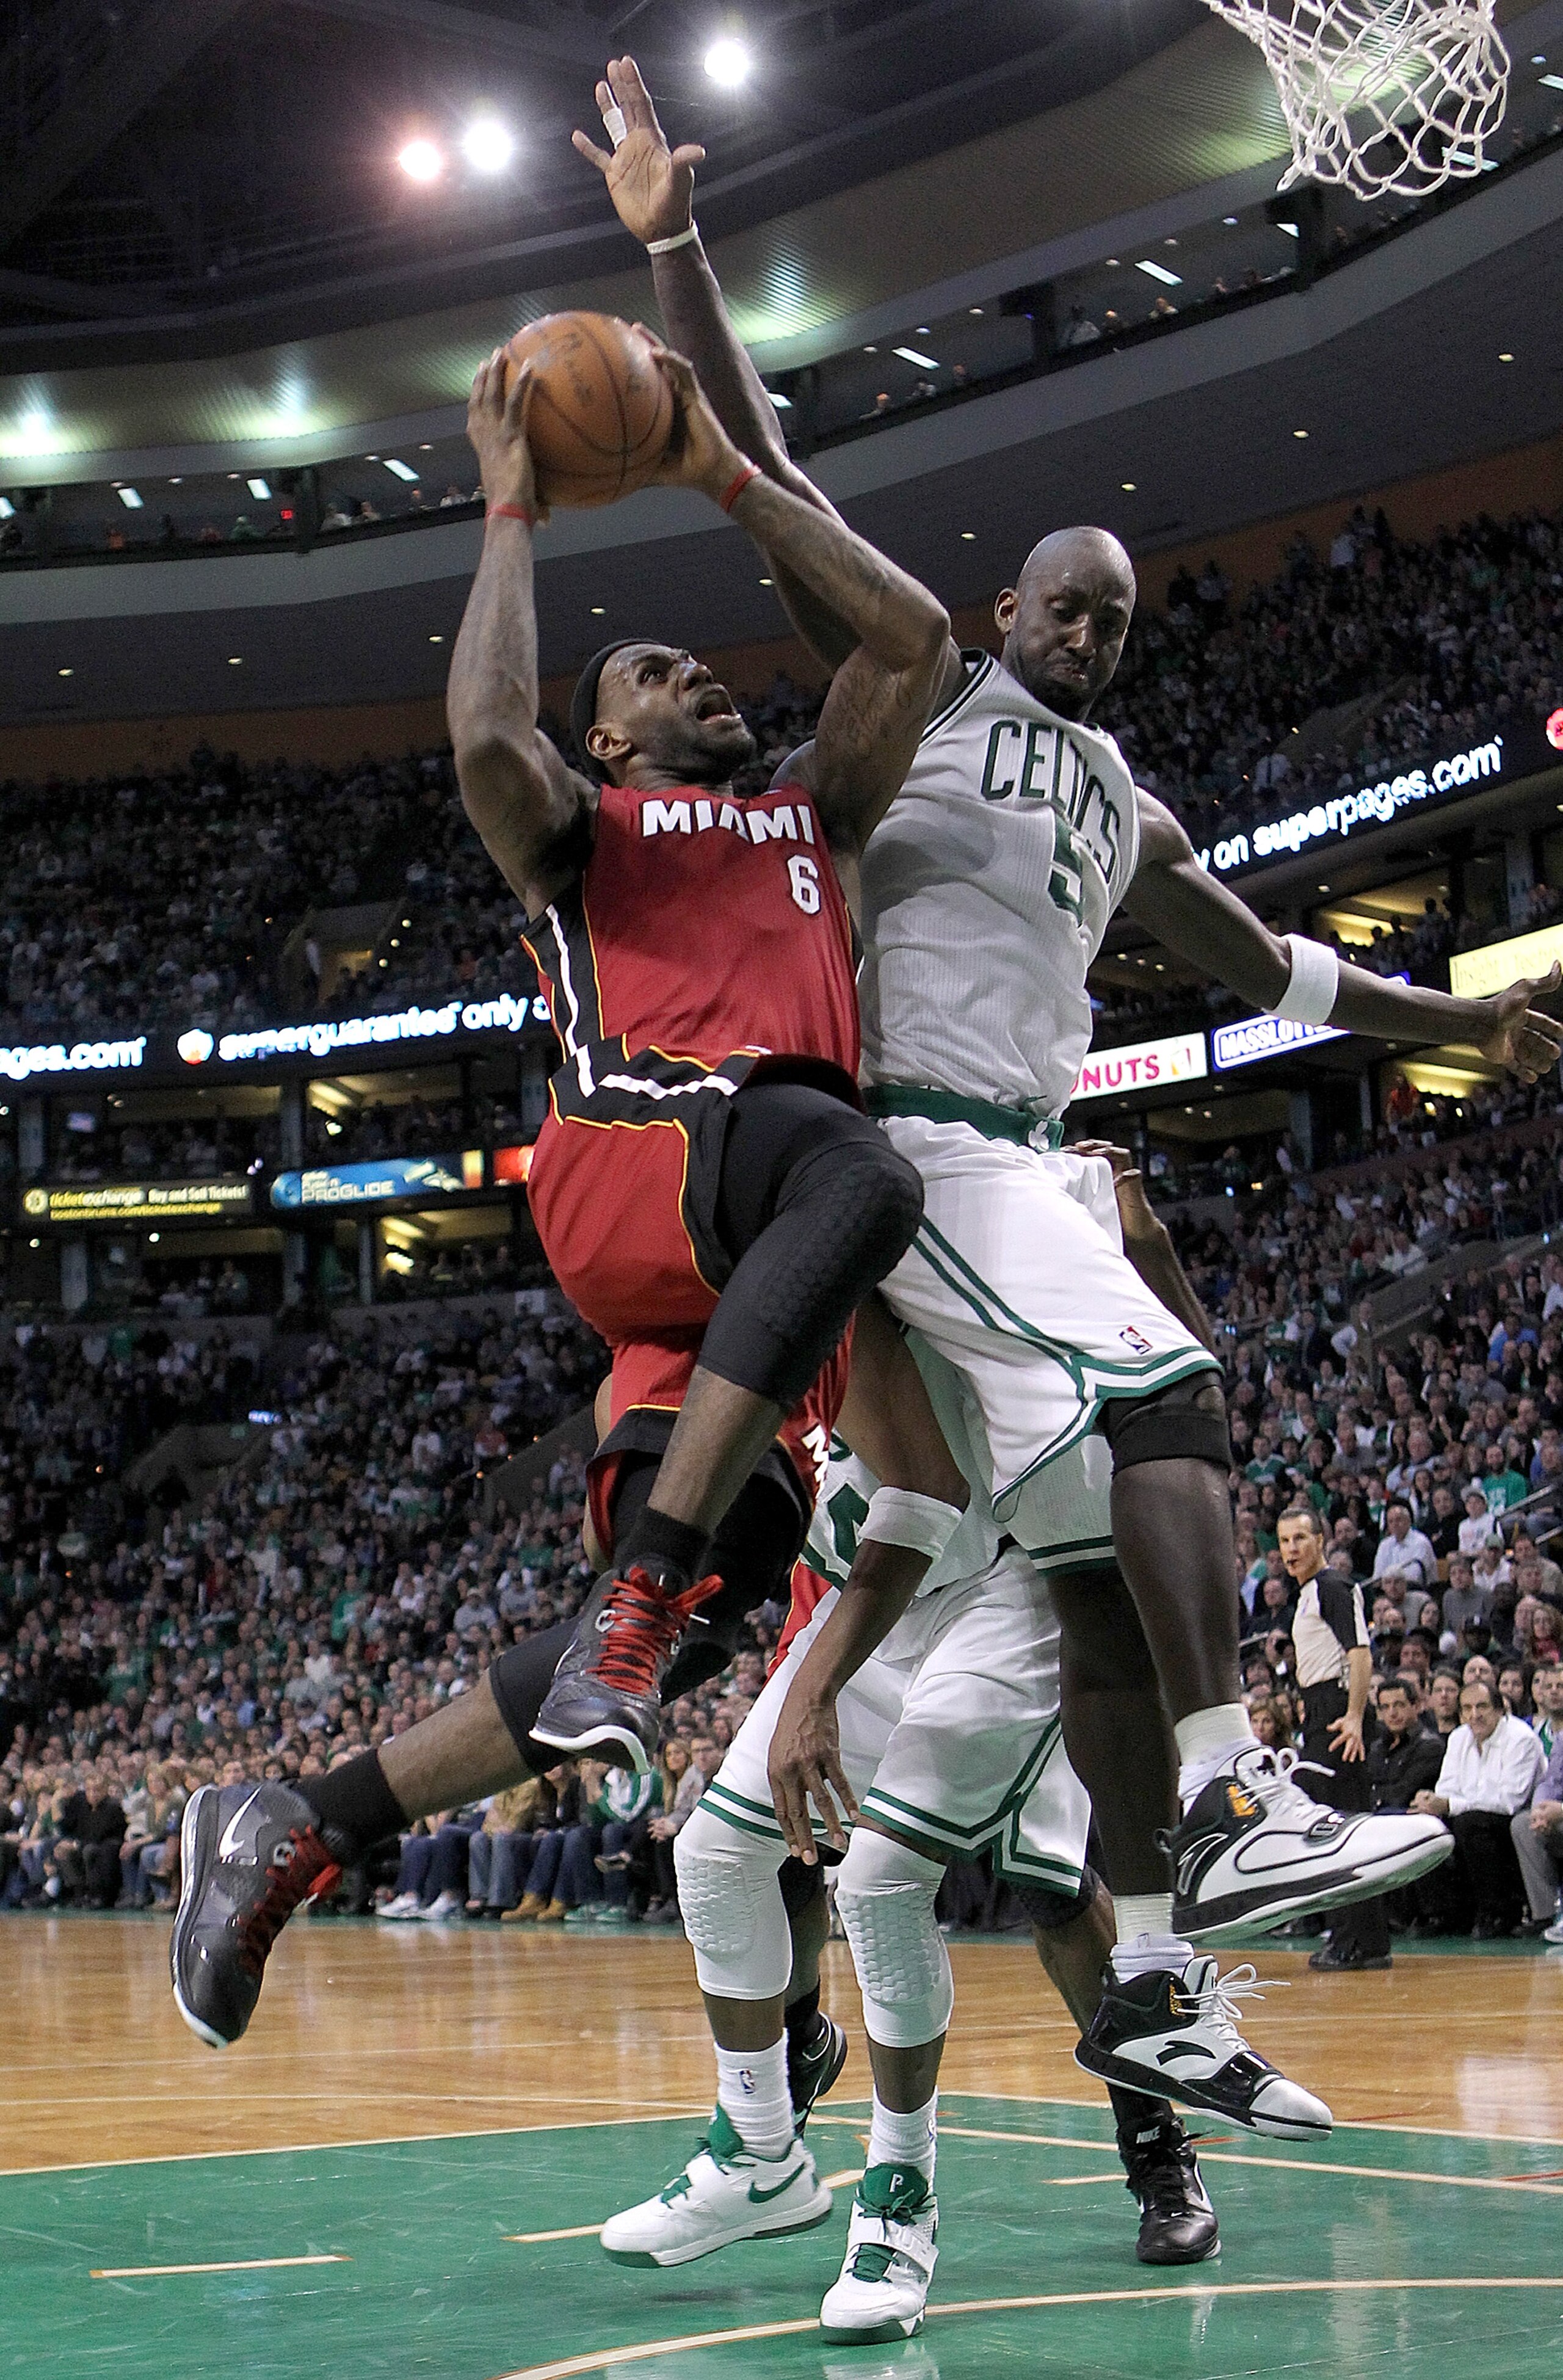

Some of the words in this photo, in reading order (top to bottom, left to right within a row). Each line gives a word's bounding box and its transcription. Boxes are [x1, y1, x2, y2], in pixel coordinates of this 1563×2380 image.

[642, 799, 815, 845] MIAMI
[1191, 845, 1211, 872] y
[1213, 834, 1250, 870] on
[1253, 741, 1502, 856] superpages.com
[787, 854, 821, 915] 6
[462, 993, 529, 1032] only
[1070, 1054, 1160, 1094] NUTS
[302, 1180, 394, 1204] PROGLIDE
[1136, 2125, 1161, 2144] NIKE
